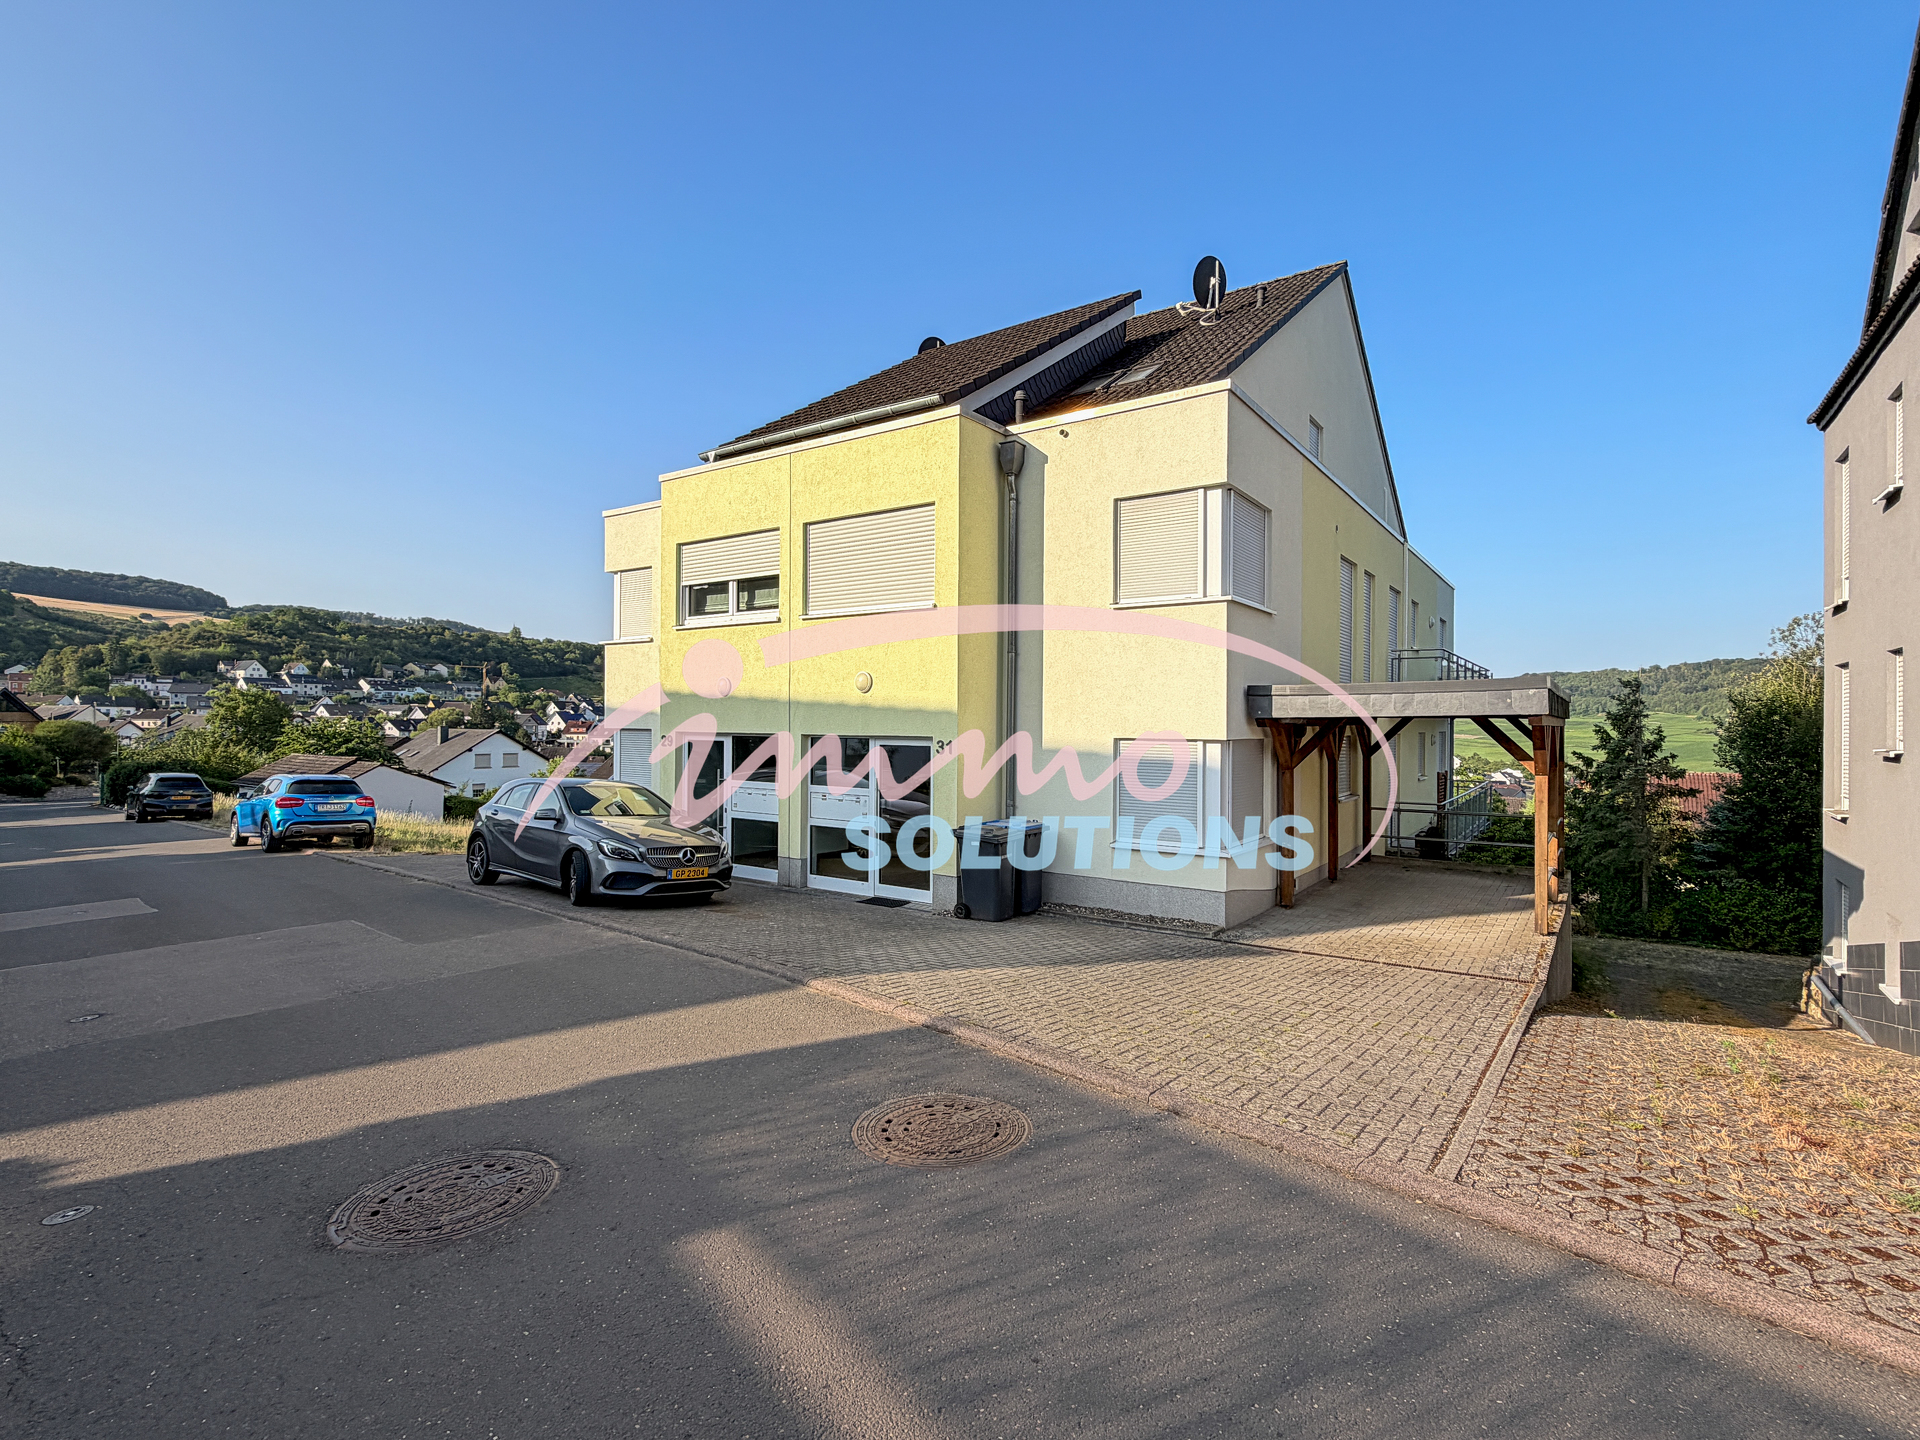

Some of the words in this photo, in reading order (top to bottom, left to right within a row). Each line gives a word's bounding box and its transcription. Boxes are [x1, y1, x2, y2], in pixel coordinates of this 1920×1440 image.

[660, 734, 674, 747] 29
[935, 739, 953, 755] 31
[675, 870, 686, 878] GP
